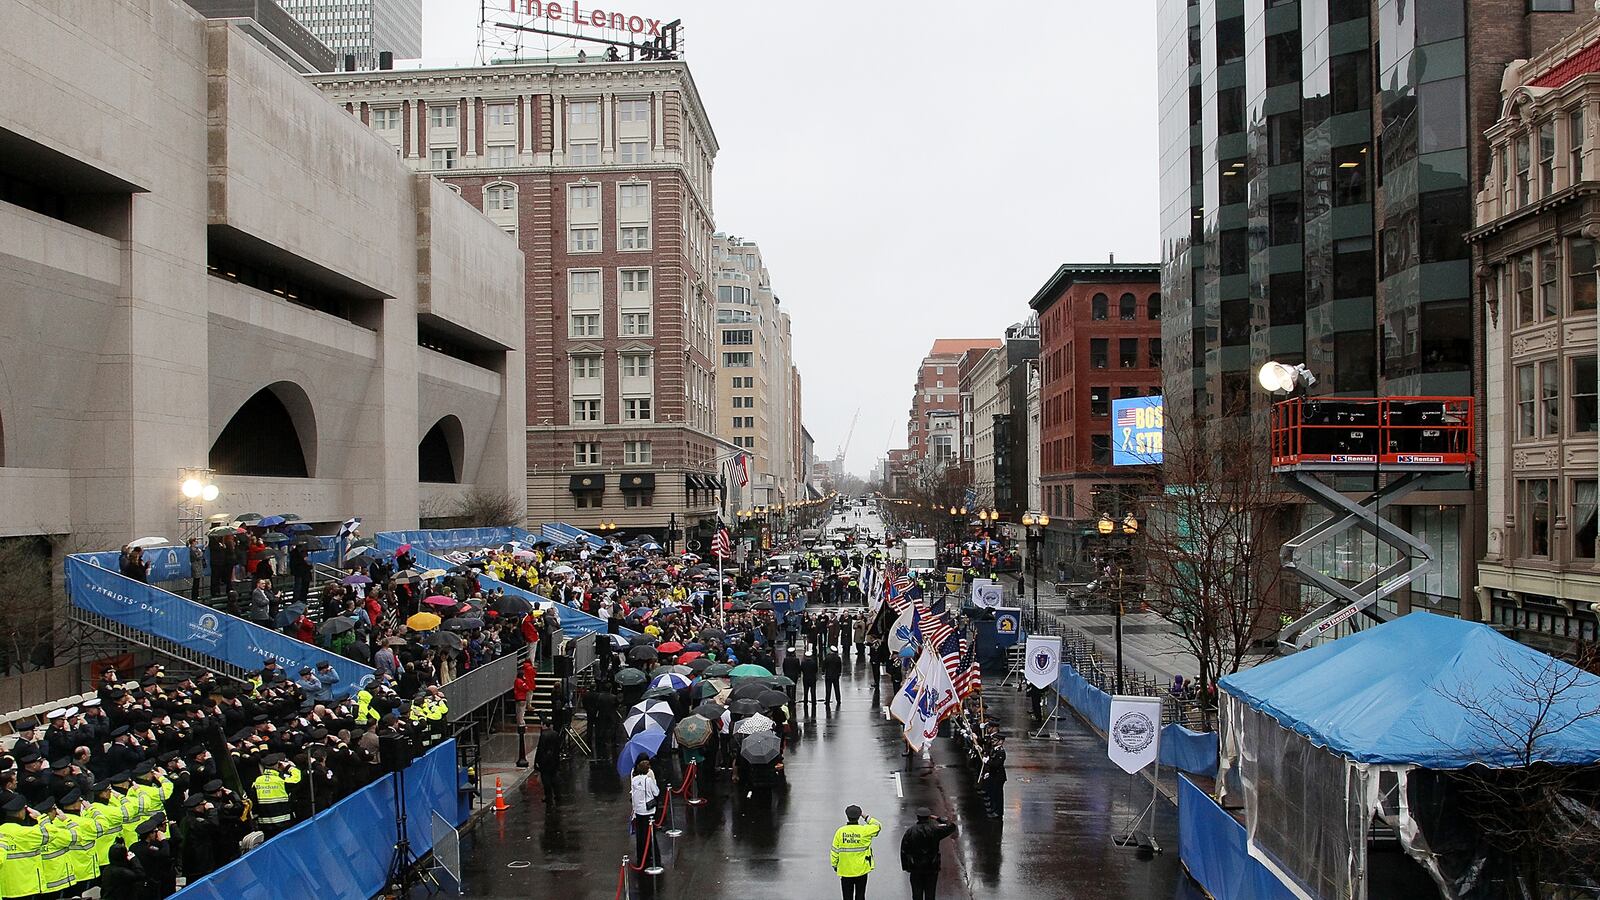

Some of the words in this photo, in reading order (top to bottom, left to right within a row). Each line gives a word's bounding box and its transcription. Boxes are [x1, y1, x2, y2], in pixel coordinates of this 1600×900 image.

[573, 0, 661, 37] Lenox
[1135, 406, 1163, 429] BOS
[141, 603, 160, 614] DAY
[1330, 606, 1357, 626] Rentals
